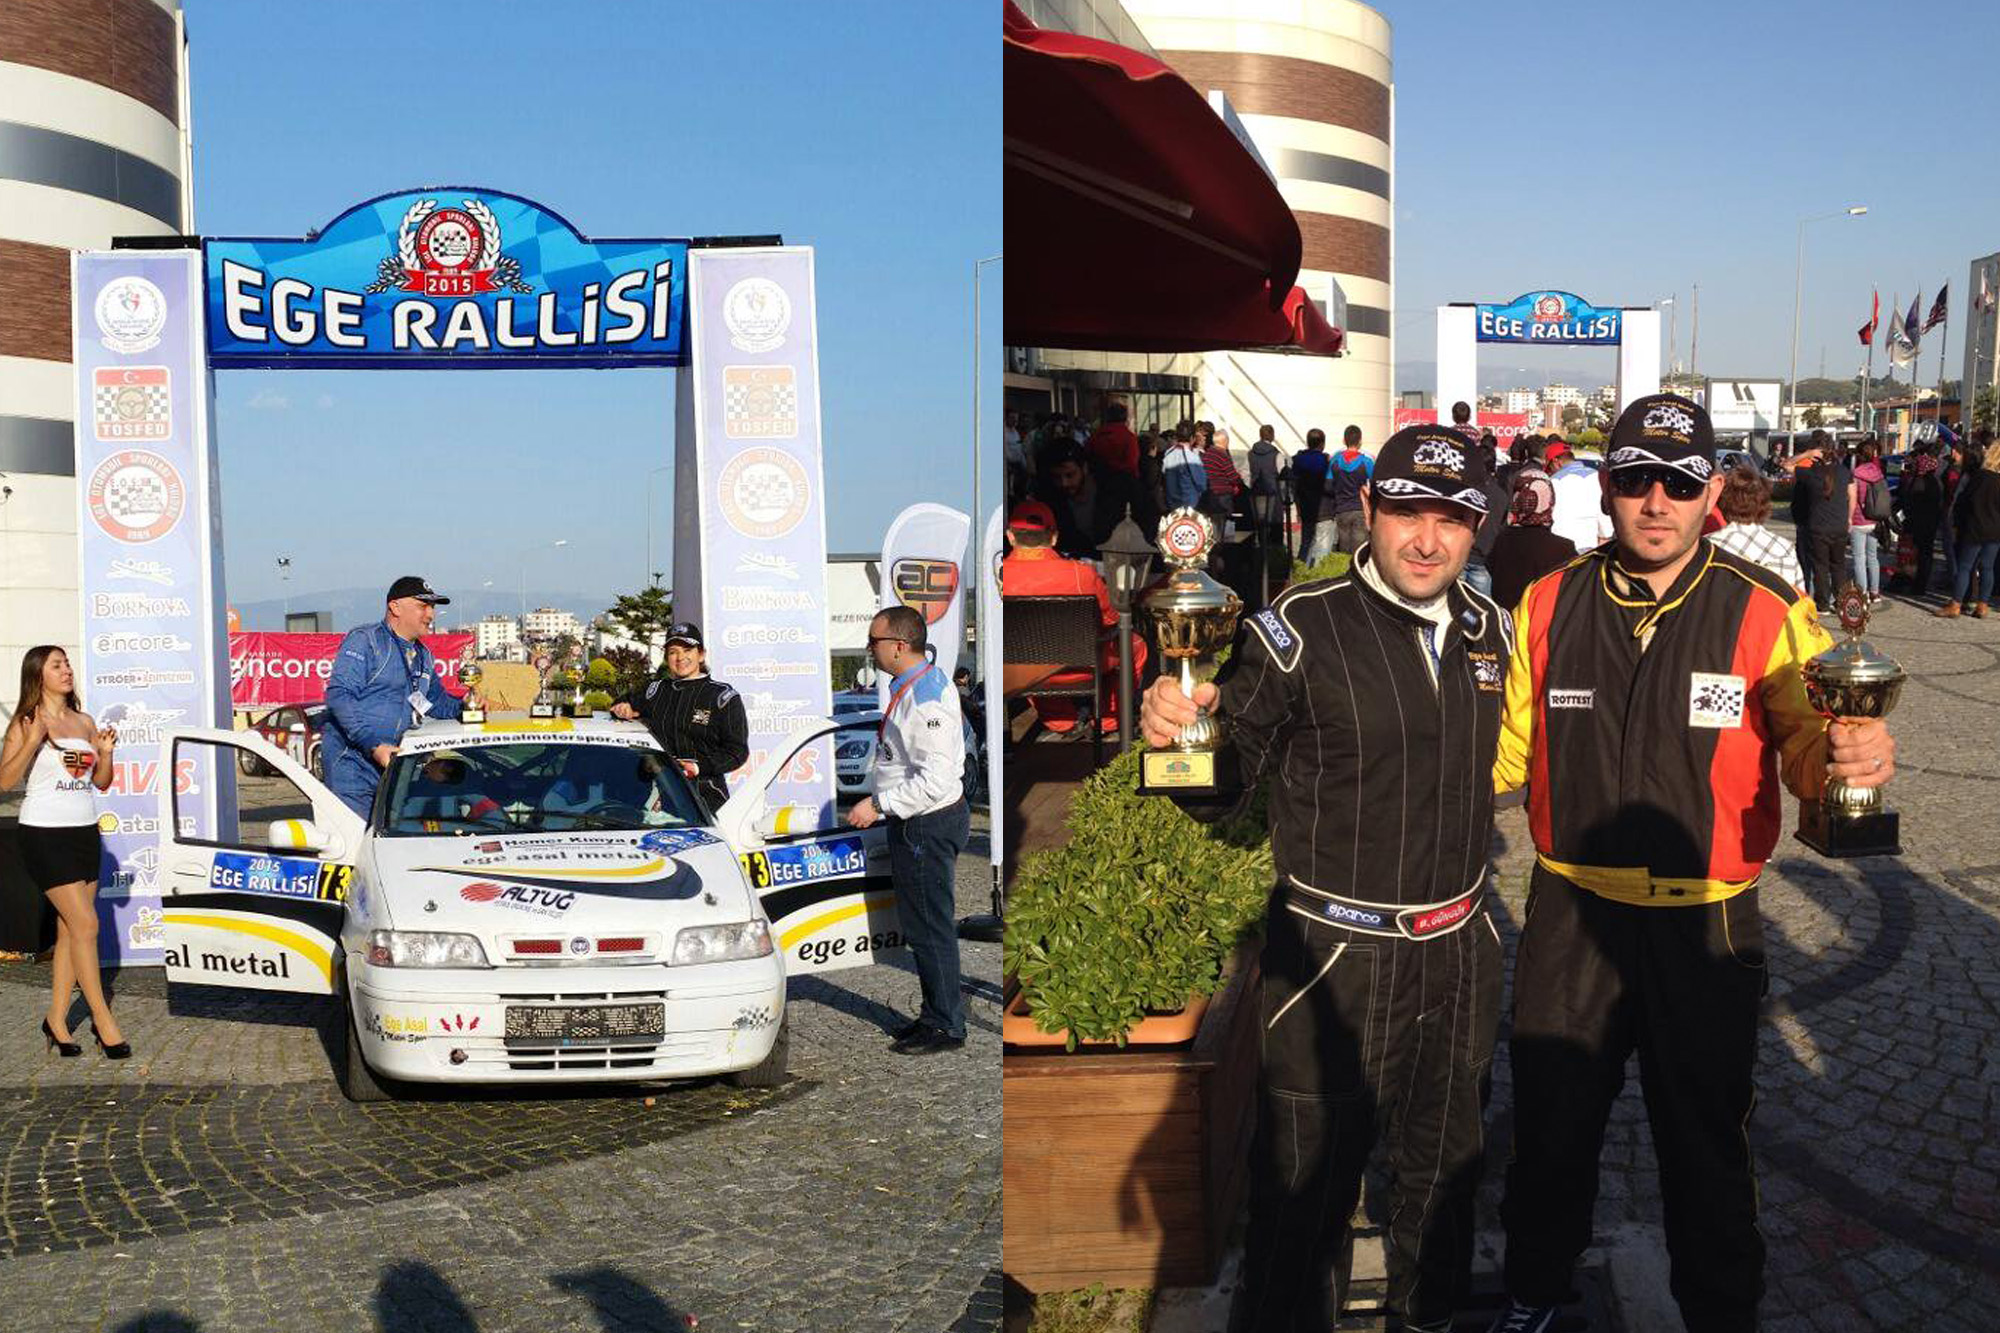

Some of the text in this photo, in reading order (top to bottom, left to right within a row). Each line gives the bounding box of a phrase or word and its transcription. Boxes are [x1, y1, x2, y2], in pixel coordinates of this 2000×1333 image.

[427, 278, 472, 293] 2015
[222, 258, 367, 348] EGE
[1481, 311, 1523, 337] EGE
[95, 592, 189, 617] BORNOVA
[727, 628, 798, 643] encore
[1261, 610, 1291, 647] sparco
[927, 719, 941, 729] FIA
[104, 761, 194, 795] AVS
[212, 865, 244, 888] EGE
[249, 858, 281, 873] 2015
[773, 862, 803, 881] EGE
[320, 864, 352, 901] 73
[1328, 903, 1381, 925] sparco
[201, 945, 290, 978] metal
[798, 937, 846, 964] ege
